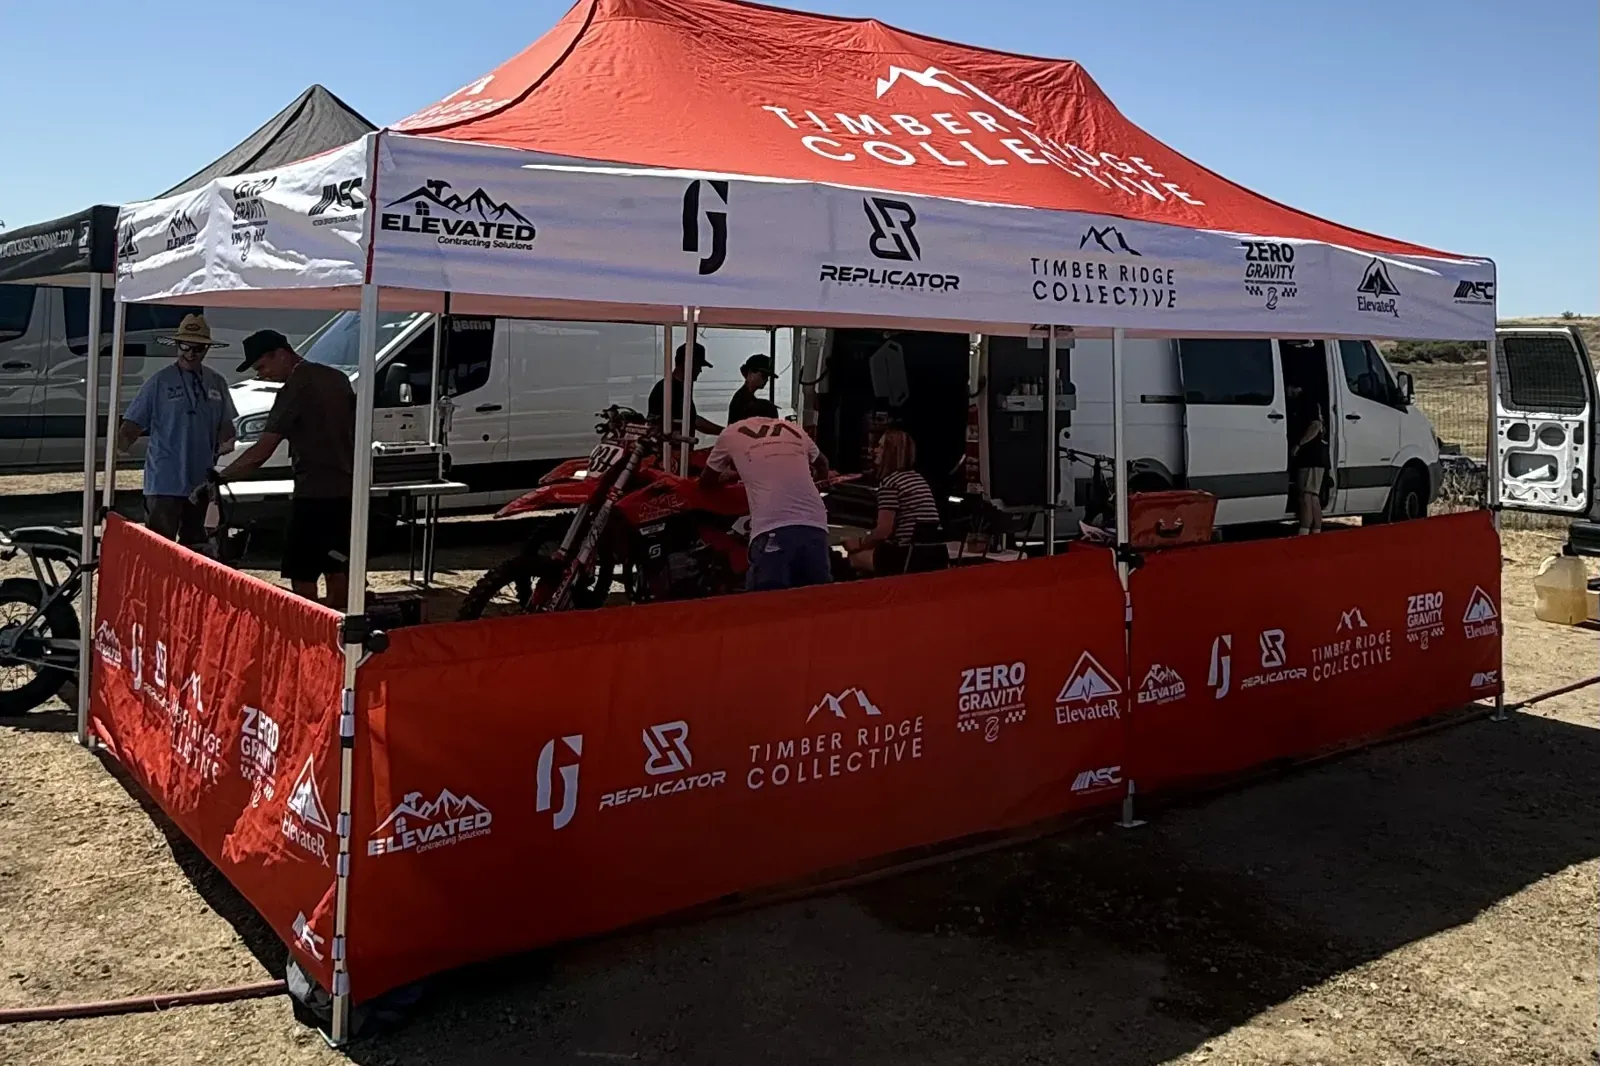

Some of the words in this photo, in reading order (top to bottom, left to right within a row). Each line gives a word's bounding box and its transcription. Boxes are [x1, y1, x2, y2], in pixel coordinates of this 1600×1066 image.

[762, 105, 1011, 136] TIMBER
[381, 213, 536, 242] ELEVATED
[438, 236, 491, 249] Contracting
[493, 240, 533, 251] Solutions
[1241, 241, 1295, 263] ZERO
[820, 265, 960, 292] REPLICATOR
[1031, 258, 1108, 280] TIMBER
[1120, 265, 1174, 286] RIDGE
[1245, 263, 1295, 280] GRAVITY
[1032, 280, 1177, 309] COLLECTIVE
[1407, 591, 1444, 614] ZERO
[1407, 608, 1443, 628] GRAVITY
[1312, 639, 1351, 664] TIMBER
[1356, 630, 1391, 650] RIDGE
[959, 661, 1026, 694] ZERO
[1312, 646, 1392, 682] COLLECTIVE
[1137, 681, 1186, 704] ELEVATED
[1241, 668, 1308, 690] REPLICATOR
[958, 685, 1025, 712] GRAVITY
[241, 705, 279, 753] ZERO
[750, 732, 842, 763] TIMBER
[857, 716, 923, 746] RIDGE
[747, 737, 923, 789] COLLECTIVE
[599, 771, 727, 811] REPLICATOR
[367, 811, 493, 857] ELEVATED
[415, 835, 457, 854] Contracting
[458, 827, 492, 842] Solutions
